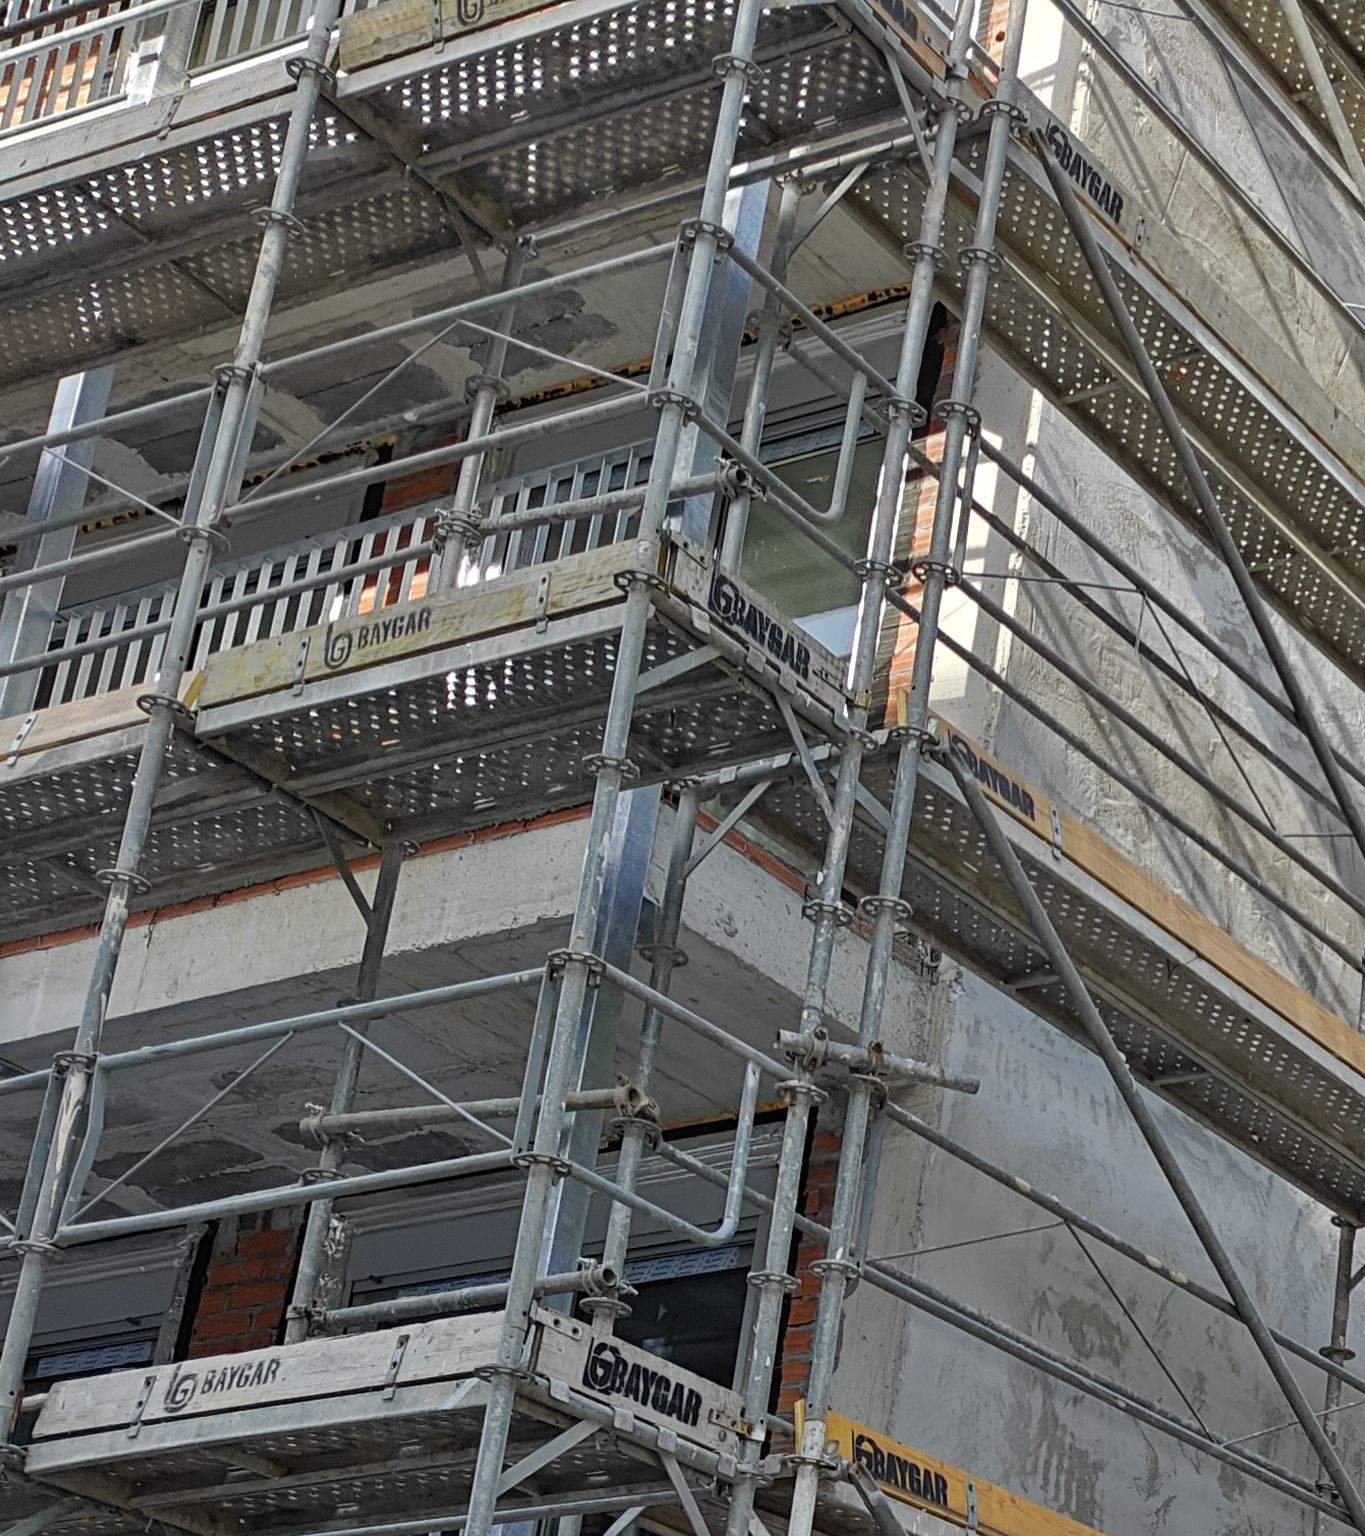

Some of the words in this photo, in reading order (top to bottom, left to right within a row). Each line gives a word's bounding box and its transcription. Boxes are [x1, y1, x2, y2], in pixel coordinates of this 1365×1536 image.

[1060, 143, 1124, 225] BAYGAR
[357, 606, 432, 650] BAYGAR
[732, 598, 812, 682] BAYGAR
[200, 1358, 282, 1395] BAYGAR
[613, 1354, 703, 1427] BAYGAR
[873, 1447, 949, 1507] BAYGAR
